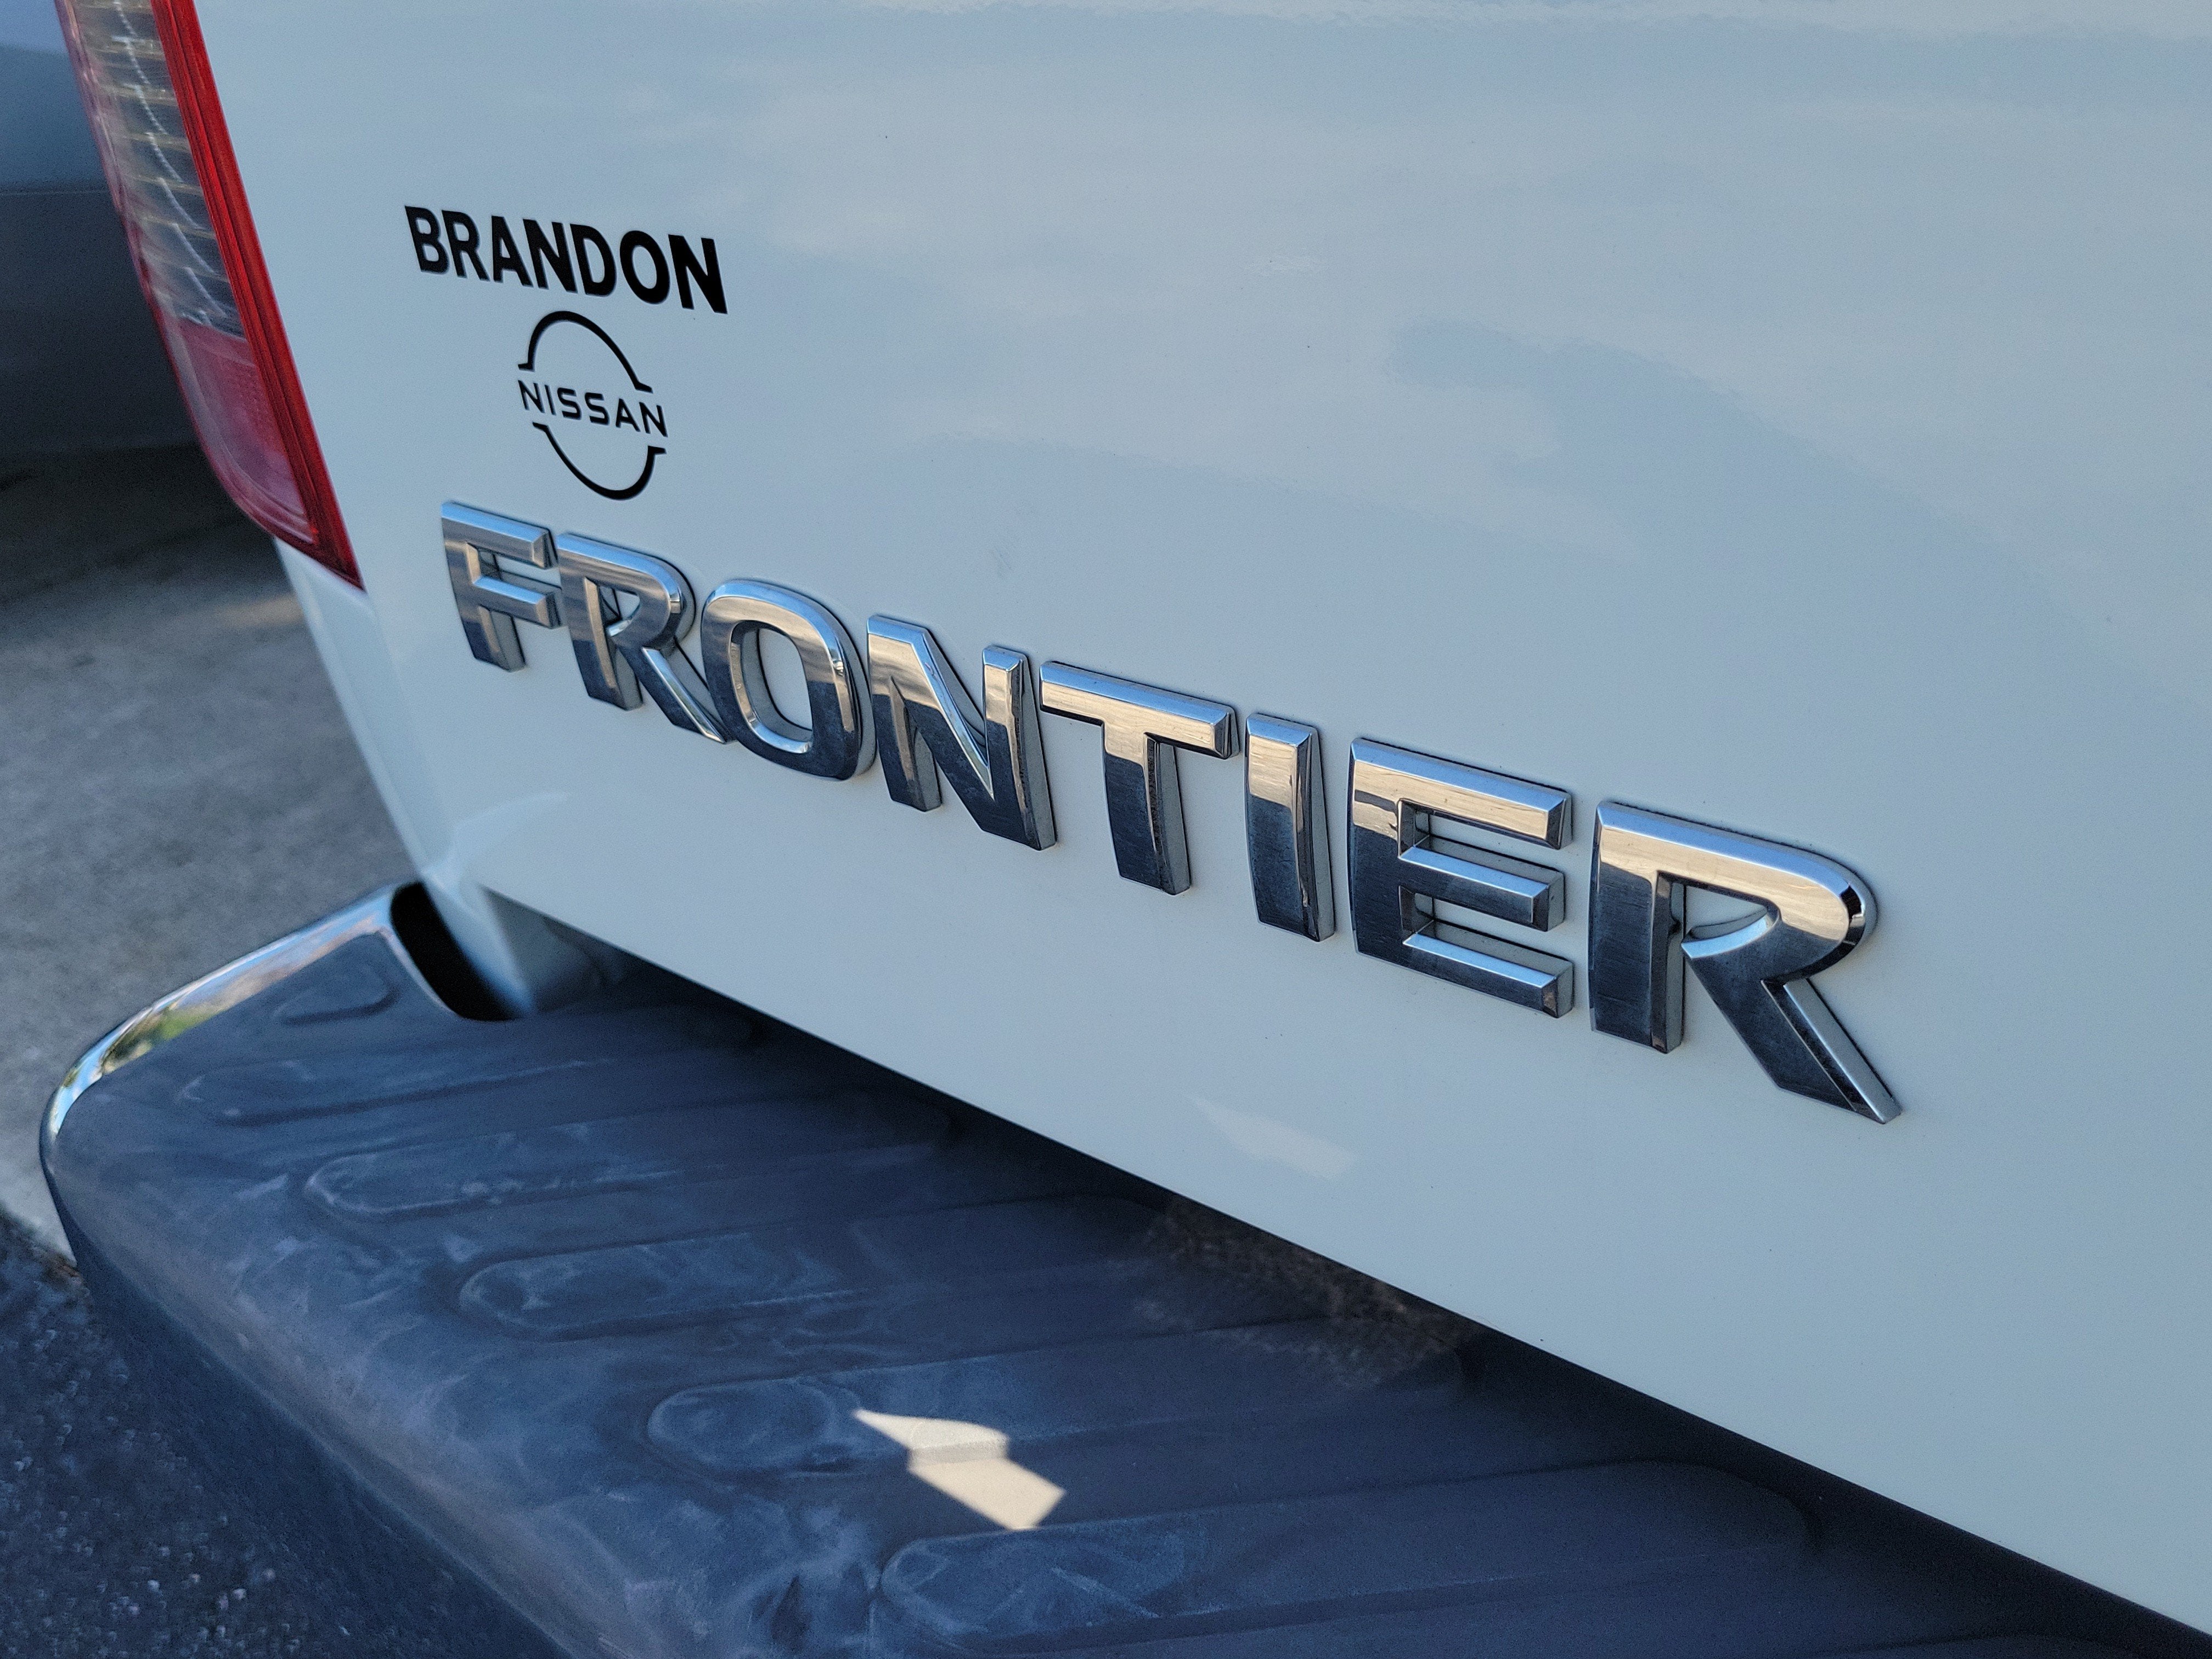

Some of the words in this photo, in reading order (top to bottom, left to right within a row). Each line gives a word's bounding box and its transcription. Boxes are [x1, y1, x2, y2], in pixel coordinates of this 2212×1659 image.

[404, 205, 728, 314] BRANDON
[517, 380, 668, 438] NISSAN
[441, 500, 1903, 1125] FRONTIER
